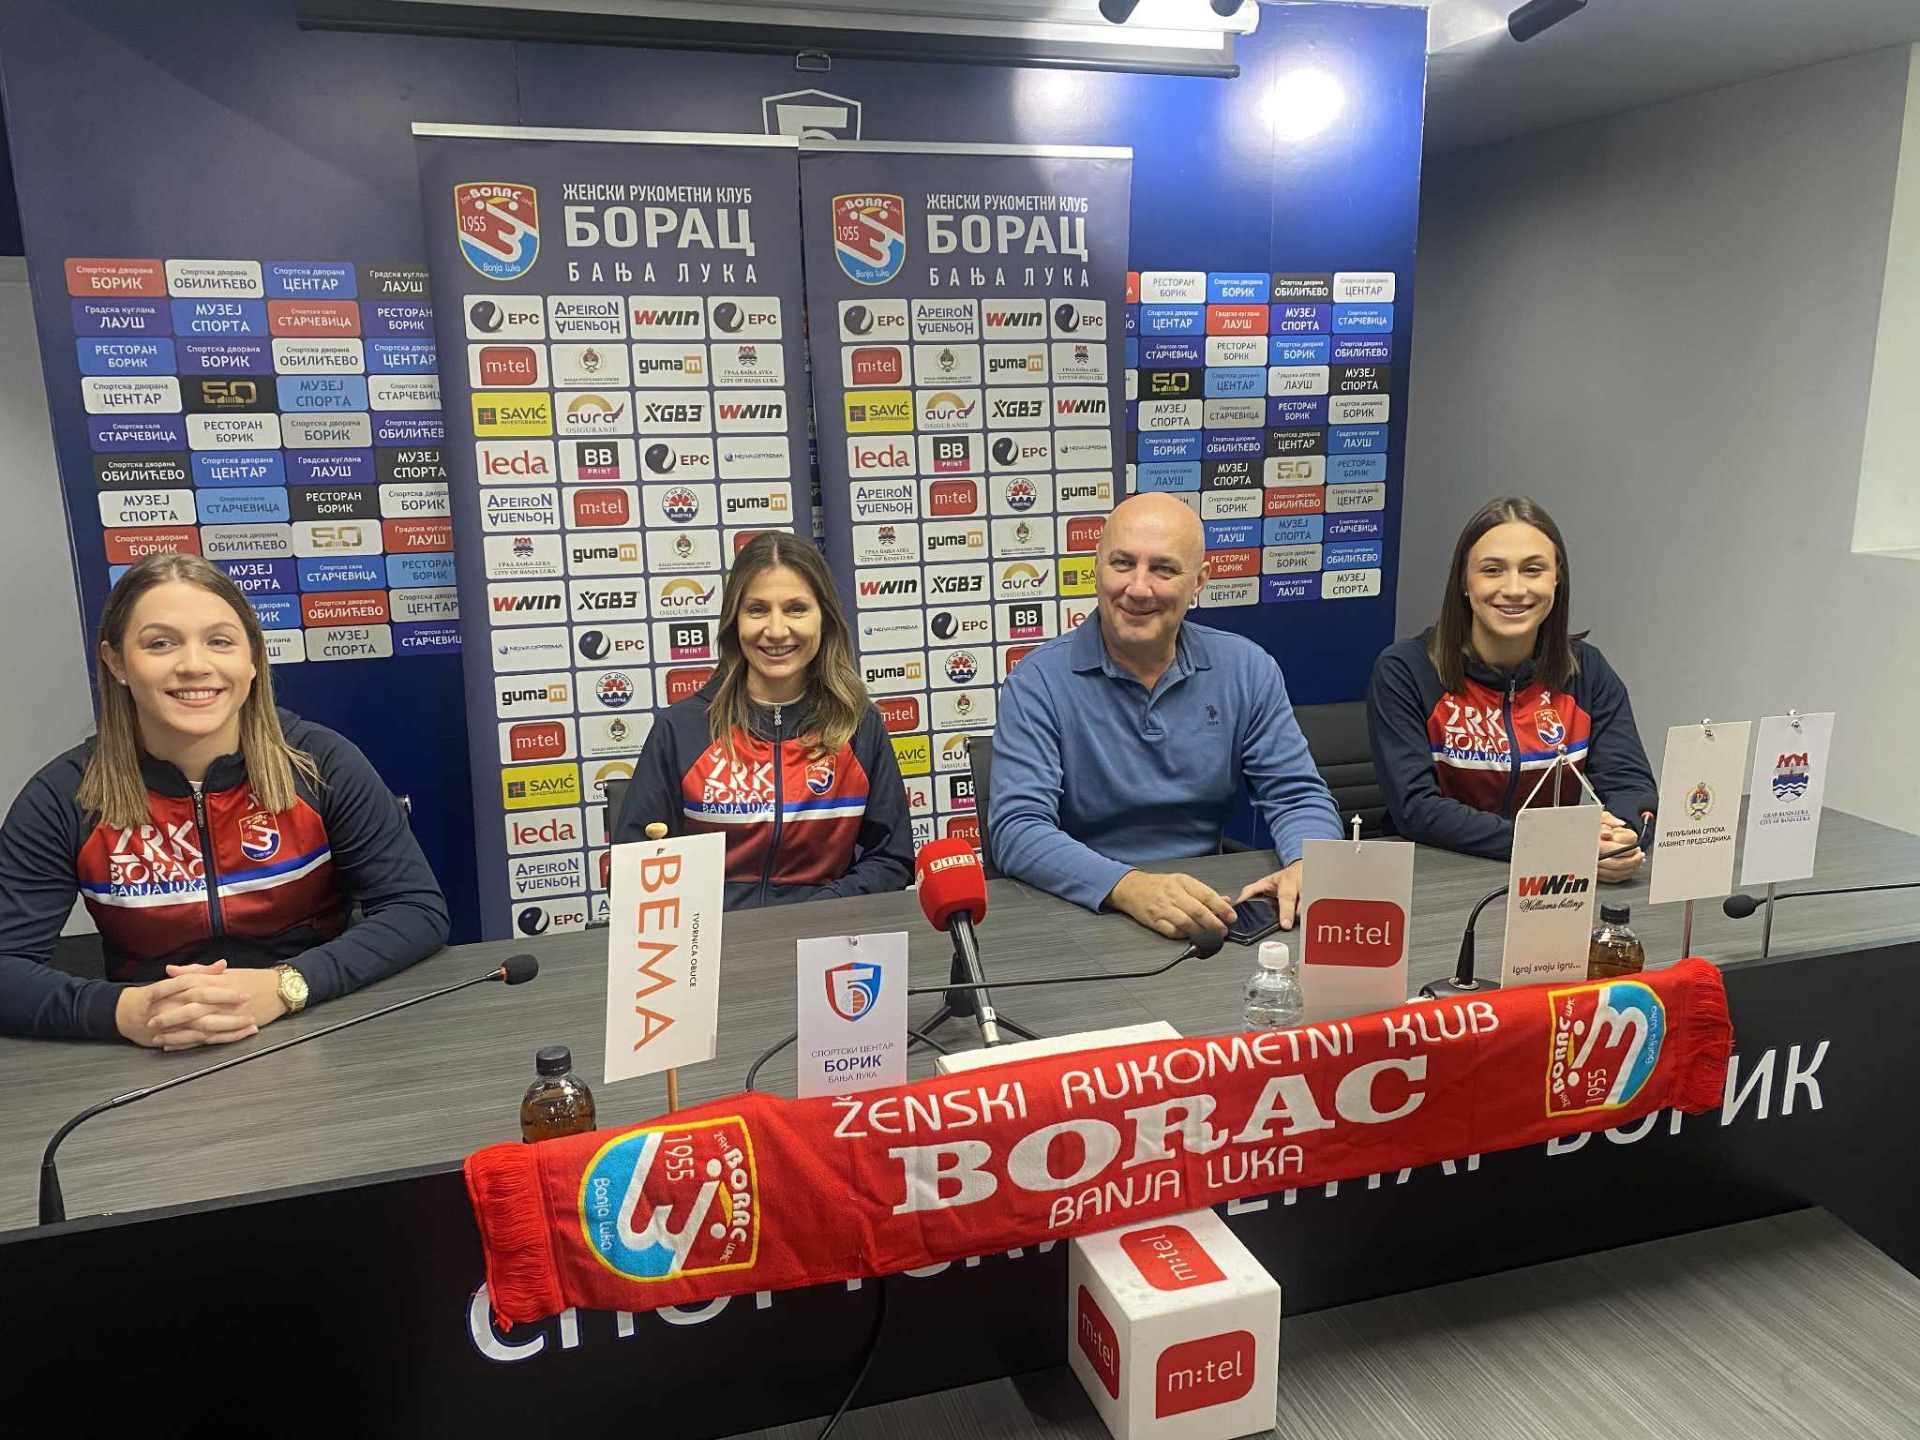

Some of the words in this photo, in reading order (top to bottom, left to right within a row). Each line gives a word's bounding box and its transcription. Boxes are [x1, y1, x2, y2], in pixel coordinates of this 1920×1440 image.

[563, 184, 624, 200] ЖЕНСКИ
[630, 185, 711, 202] РУКОМЕТНИ
[717, 187, 752, 203] КЛУБ
[927, 194, 980, 209] ЖЕНСКИ
[985, 195, 1056, 210] РУКОМЕТНИ
[1060, 197, 1088, 212] КЛУБ
[462, 216, 486, 231] 1955
[564, 206, 755, 256] БОРАЦ
[838, 226, 859, 240] 1955
[927, 215, 1088, 262] БОРАЦ
[568, 262, 655, 282] БАЊА
[678, 264, 757, 283] ЛУКА
[930, 268, 1005, 285] БАЊА
[1024, 268, 1088, 286] ЛУКА
[92, 277, 143, 289] БОРИК
[174, 278, 256, 289] ОБИЛИЋЕВО
[283, 278, 339, 291] ЦЕНТАР
[382, 281, 423, 292] ЛАУШ
[1223, 288, 1255, 297] БОРИК
[1275, 288, 1328, 296] ОБИЛИЋЕВО
[196, 304, 241, 316] МУЗЕЈ
[1286, 308, 1316, 317] МУЗЕЈ
[100, 317, 145, 328] ЛАУШ
[278, 317, 352, 328] СТАРЧЕВИЦА
[508, 313, 539, 324] EPC
[748, 314, 777, 325] EPC
[878, 315, 904, 326] EPC
[1082, 316, 1103, 326] EPC
[192, 320, 250, 332] СПОРТА
[1153, 320, 1192, 329] ЦЕНТАР
[1282, 322, 1319, 331] СПОРТА
[96, 345, 157, 355] РЕСТОРАН
[109, 359, 148, 368] БОРИК
[487, 358, 531, 373] m:tel
[857, 358, 896, 372] m:tel
[1345, 368, 1375, 378] МУЗЕЈ
[1341, 381, 1378, 391] СПОРТА
[104, 394, 161, 406] ЦЕНТАР
[500, 404, 546, 419] SAVIĆ
[870, 403, 909, 416] SAVIĆ
[1155, 404, 1187, 414] МУЗЕЈ
[1343, 409, 1374, 417] БОРИК
[1151, 416, 1190, 427] СПОРТА
[99, 432, 176, 443] СТАРЧЕВИЦА
[305, 431, 350, 440] БОРИК
[1279, 439, 1315, 449] ЦЕНТАР
[940, 443, 963, 458] BB
[398, 452, 439, 462] МУЗЕЈ
[484, 450, 548, 475] leda
[584, 449, 612, 465] BB
[680, 455, 709, 465] EPC
[855, 446, 910, 469] leda
[211, 467, 267, 480] ЦЕНТАР
[311, 467, 351, 477] ЛАУШ
[394, 467, 447, 478] СПОРТА
[1217, 464, 1248, 473] МУЗЕЈ
[102, 470, 184, 481] ОБИЛИЋЕВО
[1214, 476, 1251, 486] СПОРТА
[124, 495, 170, 506] МУЗЕЈ
[306, 493, 361, 501] РЕСТОРАН
[318, 505, 353, 513] БОРИК
[580, 499, 623, 514] m:tel
[120, 511, 178, 522] СПОРТА
[209, 540, 287, 552] ОБИЛИЋЕВО
[307, 571, 377, 582] СТАРЧЕВИЦА
[1337, 574, 1365, 582] МУЗЕЈ
[1277, 586, 1305, 596] ЛАУШ
[1333, 585, 1368, 593] СПОРТА
[962, 621, 988, 631] EPC
[328, 630, 368, 641] МУЗЕЈ
[677, 630, 703, 646] BB
[323, 645, 376, 656] СПОРТА
[516, 732, 560, 749] m:tel
[530, 775, 574, 791] SAVIĆ
[513, 819, 575, 845] leda
[554, 913, 583, 925] EPC
[1318, 921, 1391, 945] m:tel
[634, 854, 681, 1051] BEMA
[812, 1048, 857, 1057] СПОРТСКИ
[825, 1055, 882, 1072] БОРИК
[831, 1081, 1028, 1138] ŽENSKI
[1060, 1023, 1354, 1109] RUKOMETNI
[1383, 1002, 1499, 1047] KLUB
[1585, 1069, 1606, 1104] 1955
[889, 1054, 1427, 1215] BORAC
[665, 1134, 695, 1181] 1955
[1048, 1169, 1181, 1229] BANJA
[1207, 1145, 1303, 1189] LUKA
[724, 1148, 750, 1242] BORAC
[1141, 1234, 1197, 1281] m:tel
[1083, 1312, 1115, 1376] m:tel
[1168, 1351, 1242, 1392] m:tel
